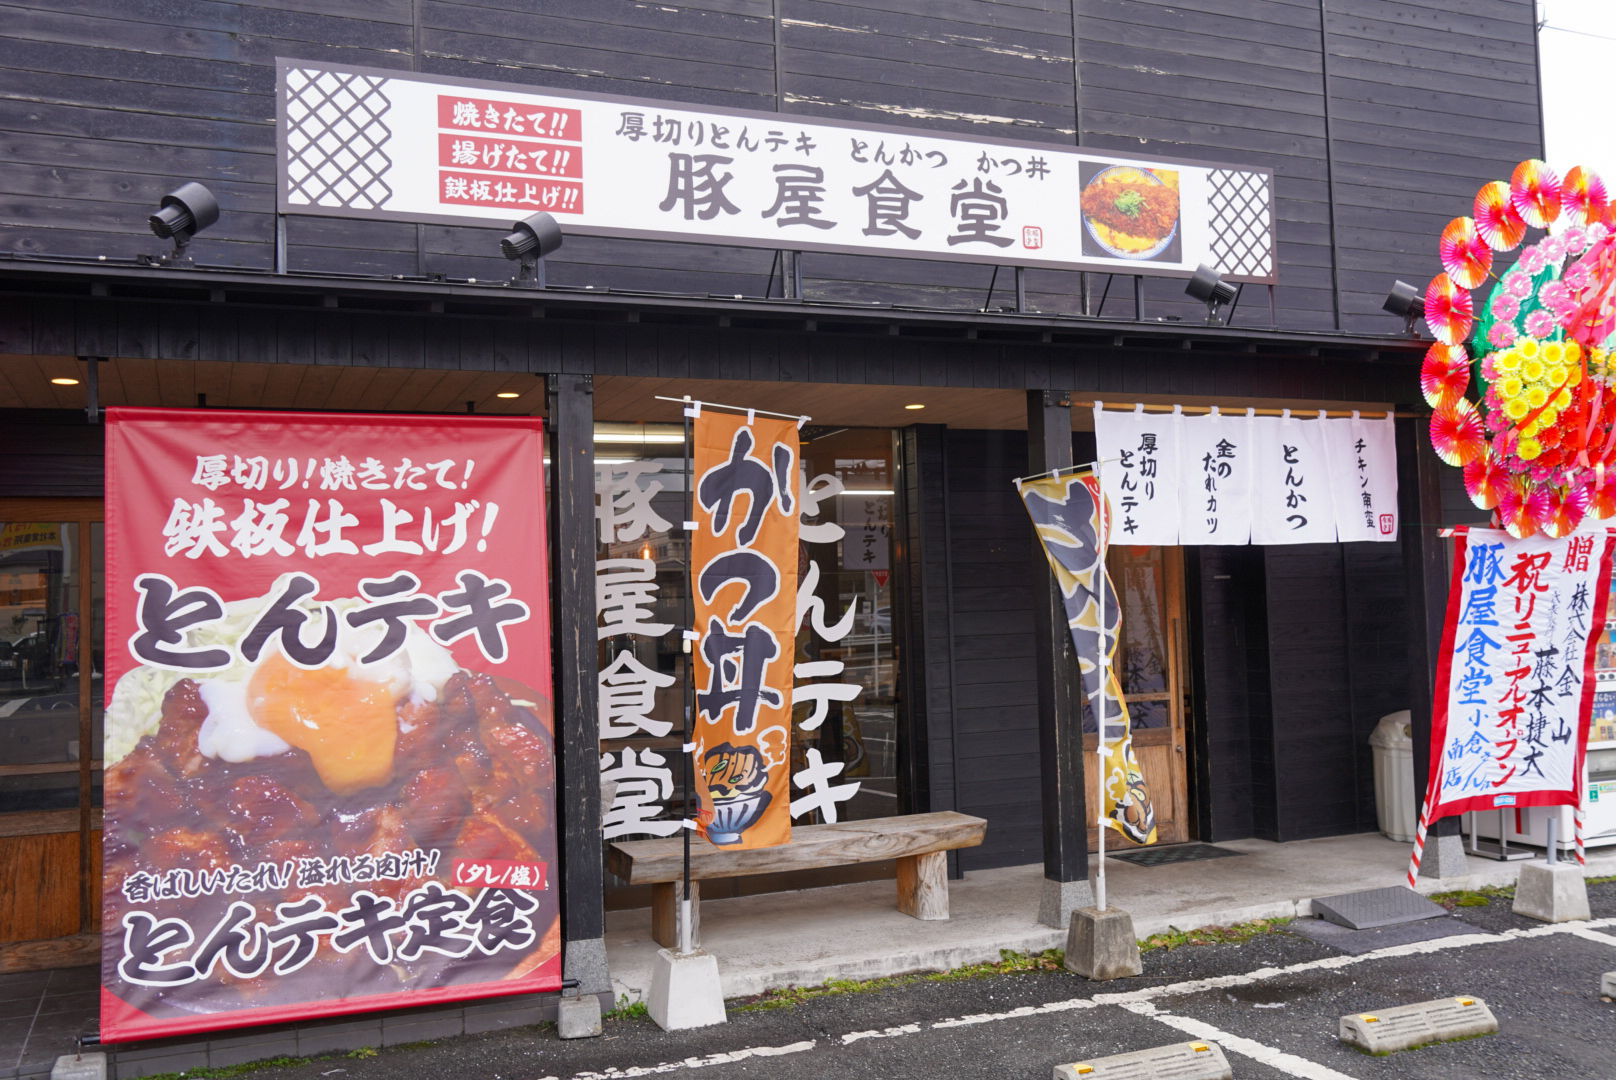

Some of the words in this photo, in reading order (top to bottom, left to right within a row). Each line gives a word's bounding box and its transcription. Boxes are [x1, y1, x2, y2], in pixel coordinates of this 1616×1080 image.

[452, 101, 569, 137] 焼きたて!!
[615, 111, 817, 157] 厚切りとんテキ
[851, 138, 948, 169] とんかつ
[444, 176, 579, 210] 鉄板仕上げ!!
[451, 139, 571, 175] 揚げたて!!
[659, 151, 1016, 249] 豚屋食堂
[1120, 449, 1139, 535] とんテキ
[1138, 433, 1158, 500] 厚切り
[1202, 452, 1218, 534] たれカツ
[1216, 438, 1237, 478] 金の
[1283, 444, 1308, 530] とんかつ
[1354, 438, 1375, 529] チキン南蛮
[161, 497, 500, 560] 鉄板仕上げ!
[1561, 535, 1595, 574] 贈
[128, 569, 531, 674] とんテキ
[1455, 542, 1508, 706] 豚屋食堂
[118, 880, 540, 987] とんテキ定食
